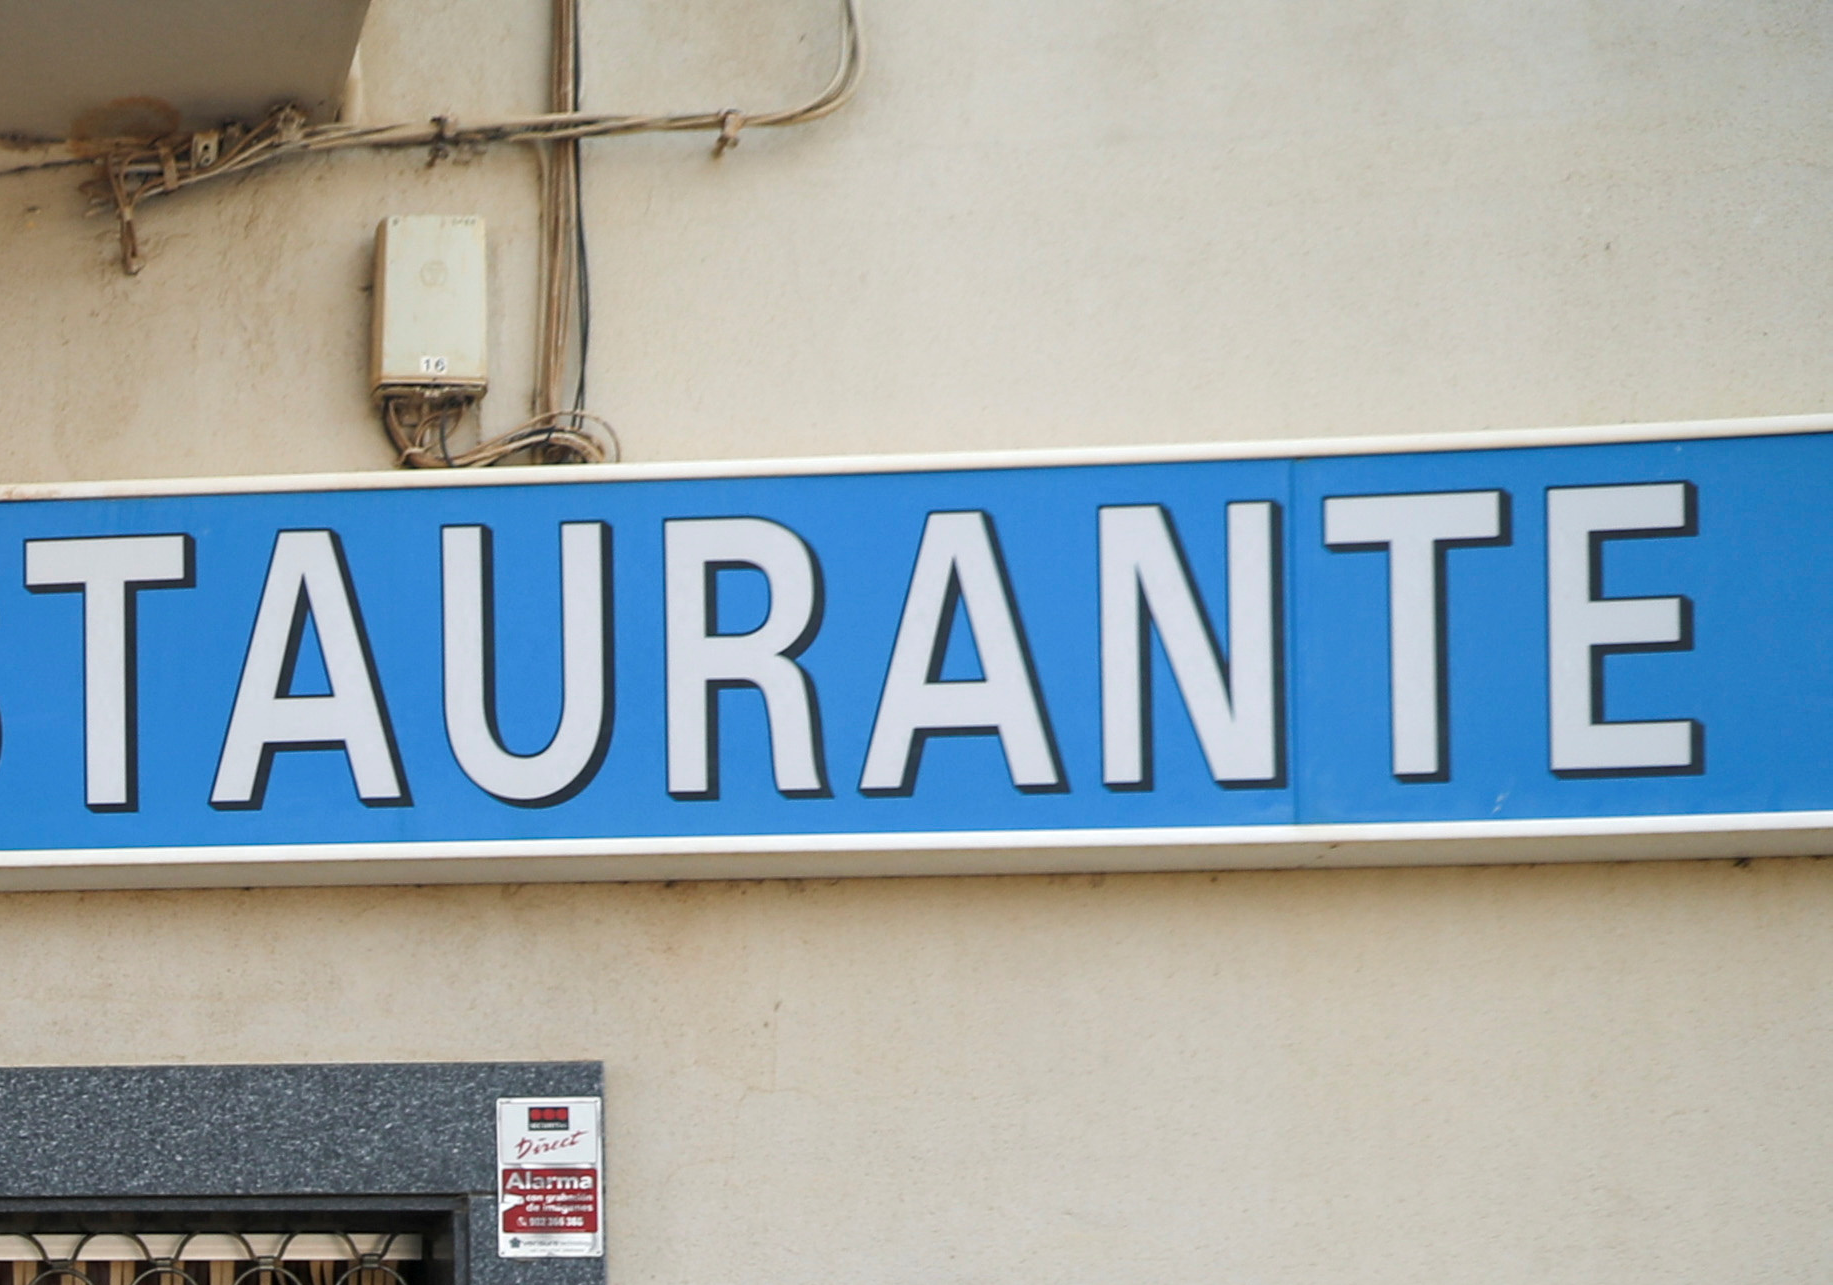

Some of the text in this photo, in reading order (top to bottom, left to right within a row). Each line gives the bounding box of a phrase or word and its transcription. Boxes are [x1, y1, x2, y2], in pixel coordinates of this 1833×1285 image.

[423, 357, 447, 373] 16
[514, 1130, 589, 1160] Direct
[505, 1171, 593, 1190] Alarma
[526, 1194, 544, 1202] con
[525, 1203, 541, 1212] de
